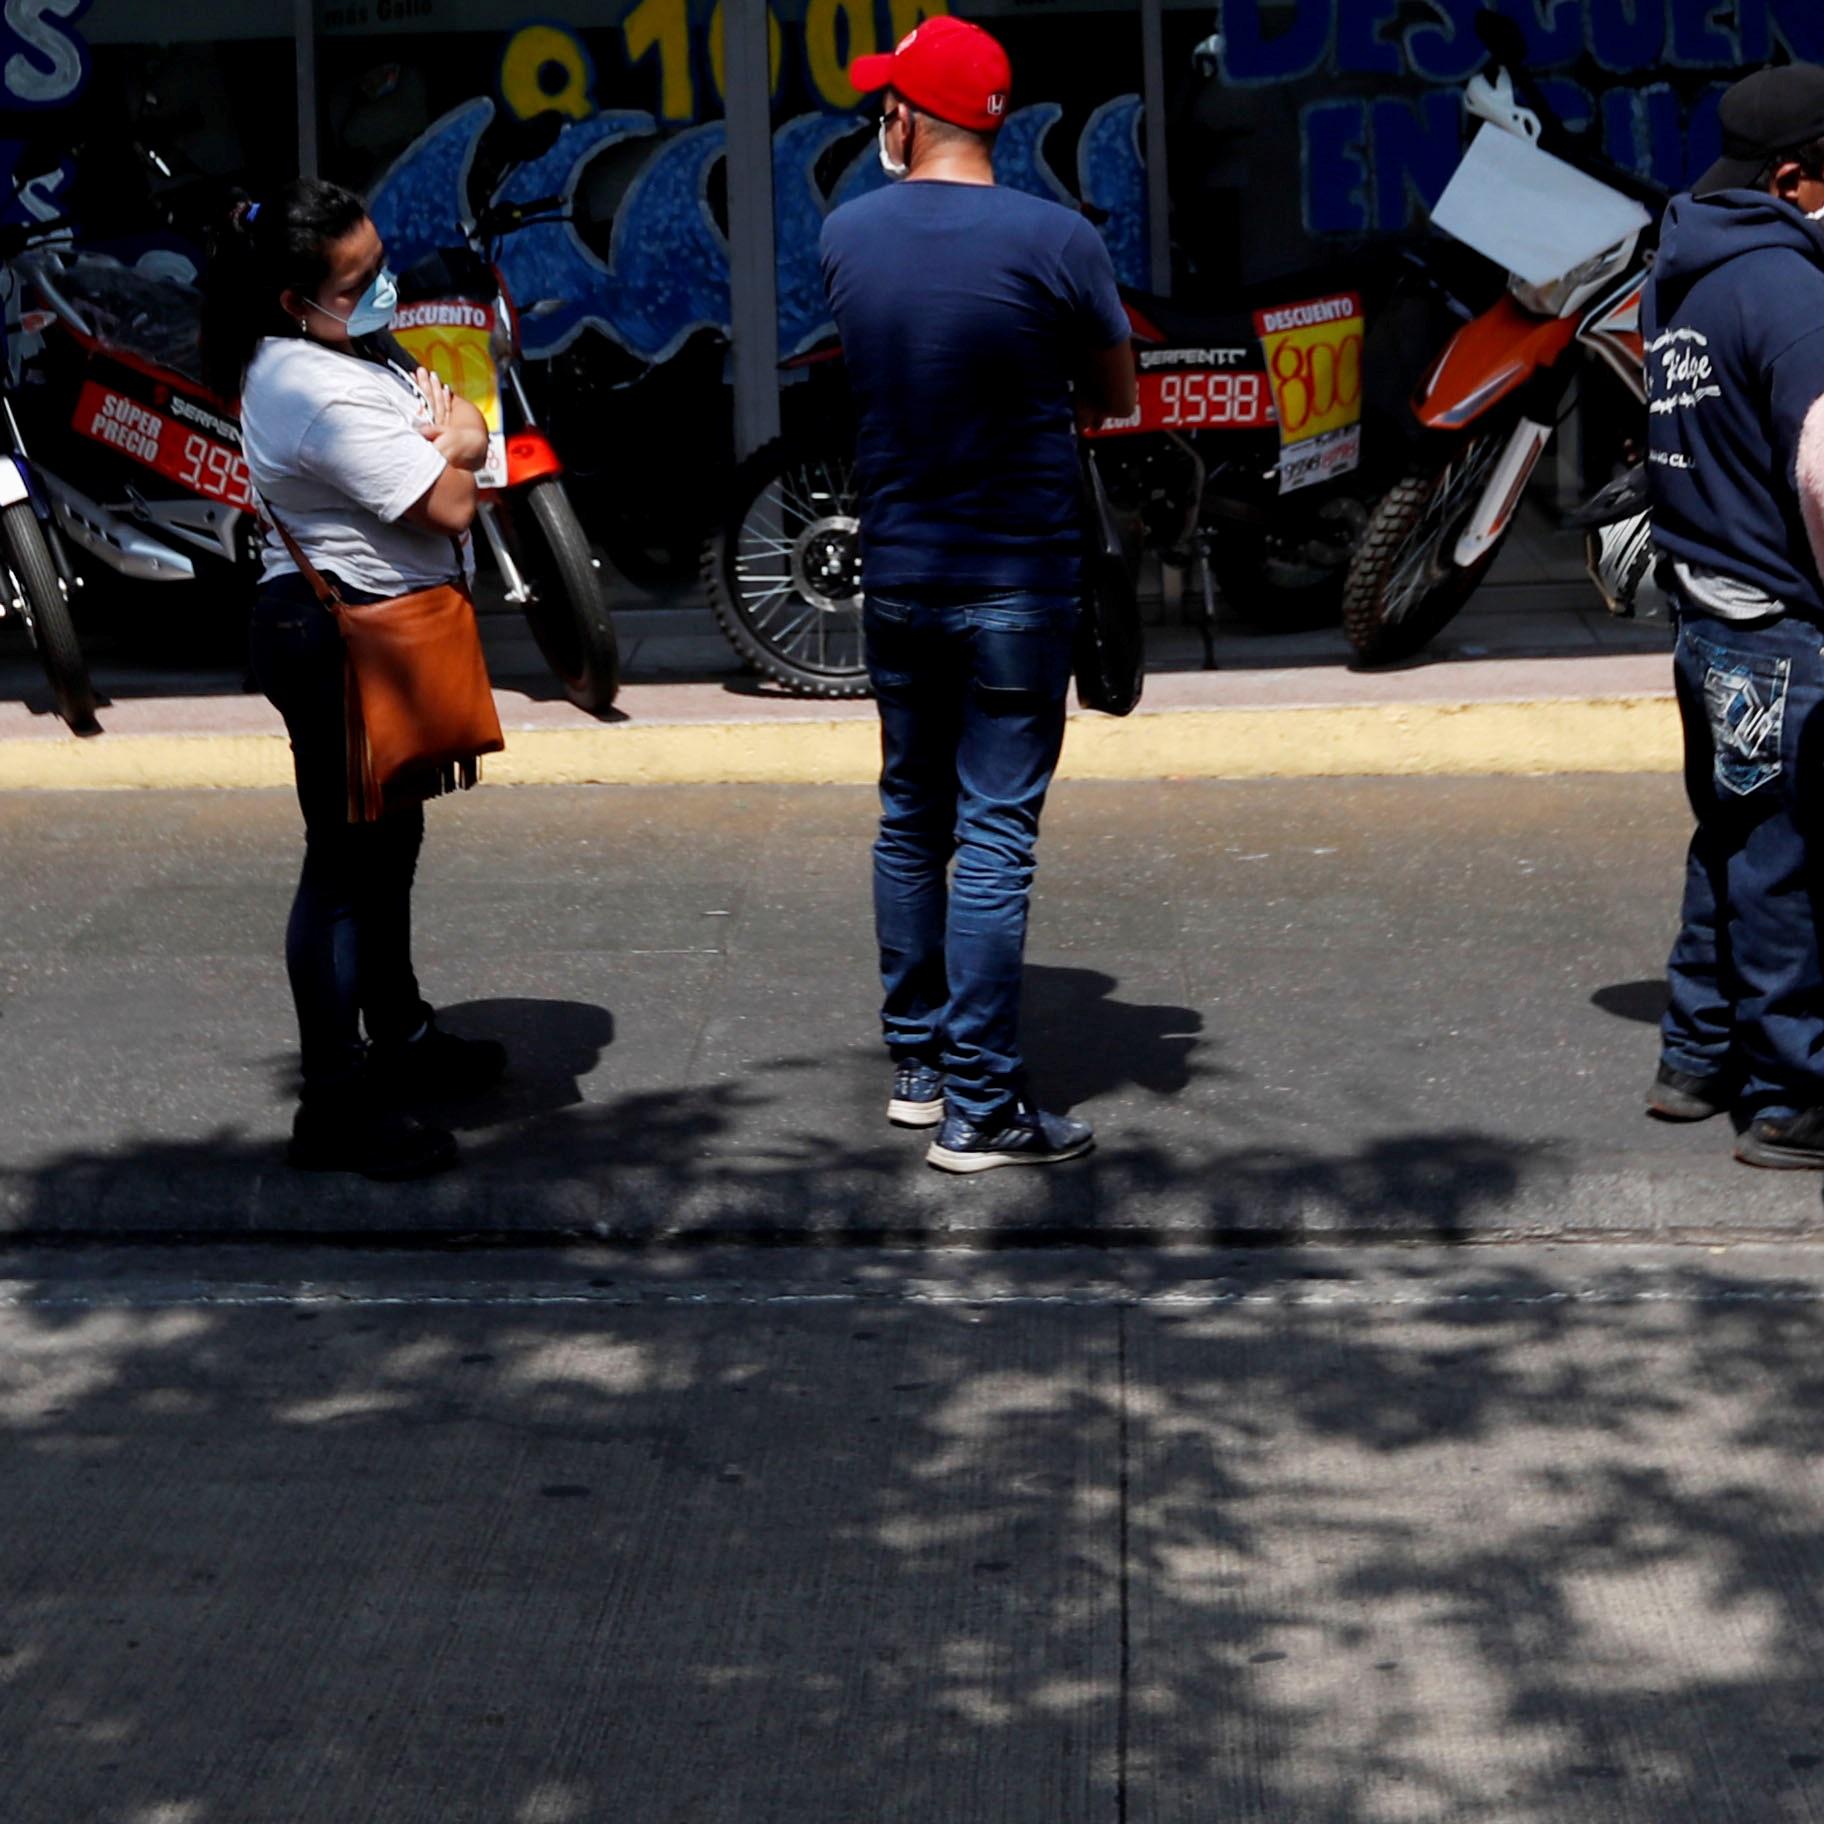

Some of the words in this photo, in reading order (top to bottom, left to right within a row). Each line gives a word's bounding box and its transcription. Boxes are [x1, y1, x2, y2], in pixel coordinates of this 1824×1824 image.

[1262, 297, 1354, 333] DESCUENTO
[1272, 334, 1363, 432] 800
[90, 412, 160, 463] PRECIO
